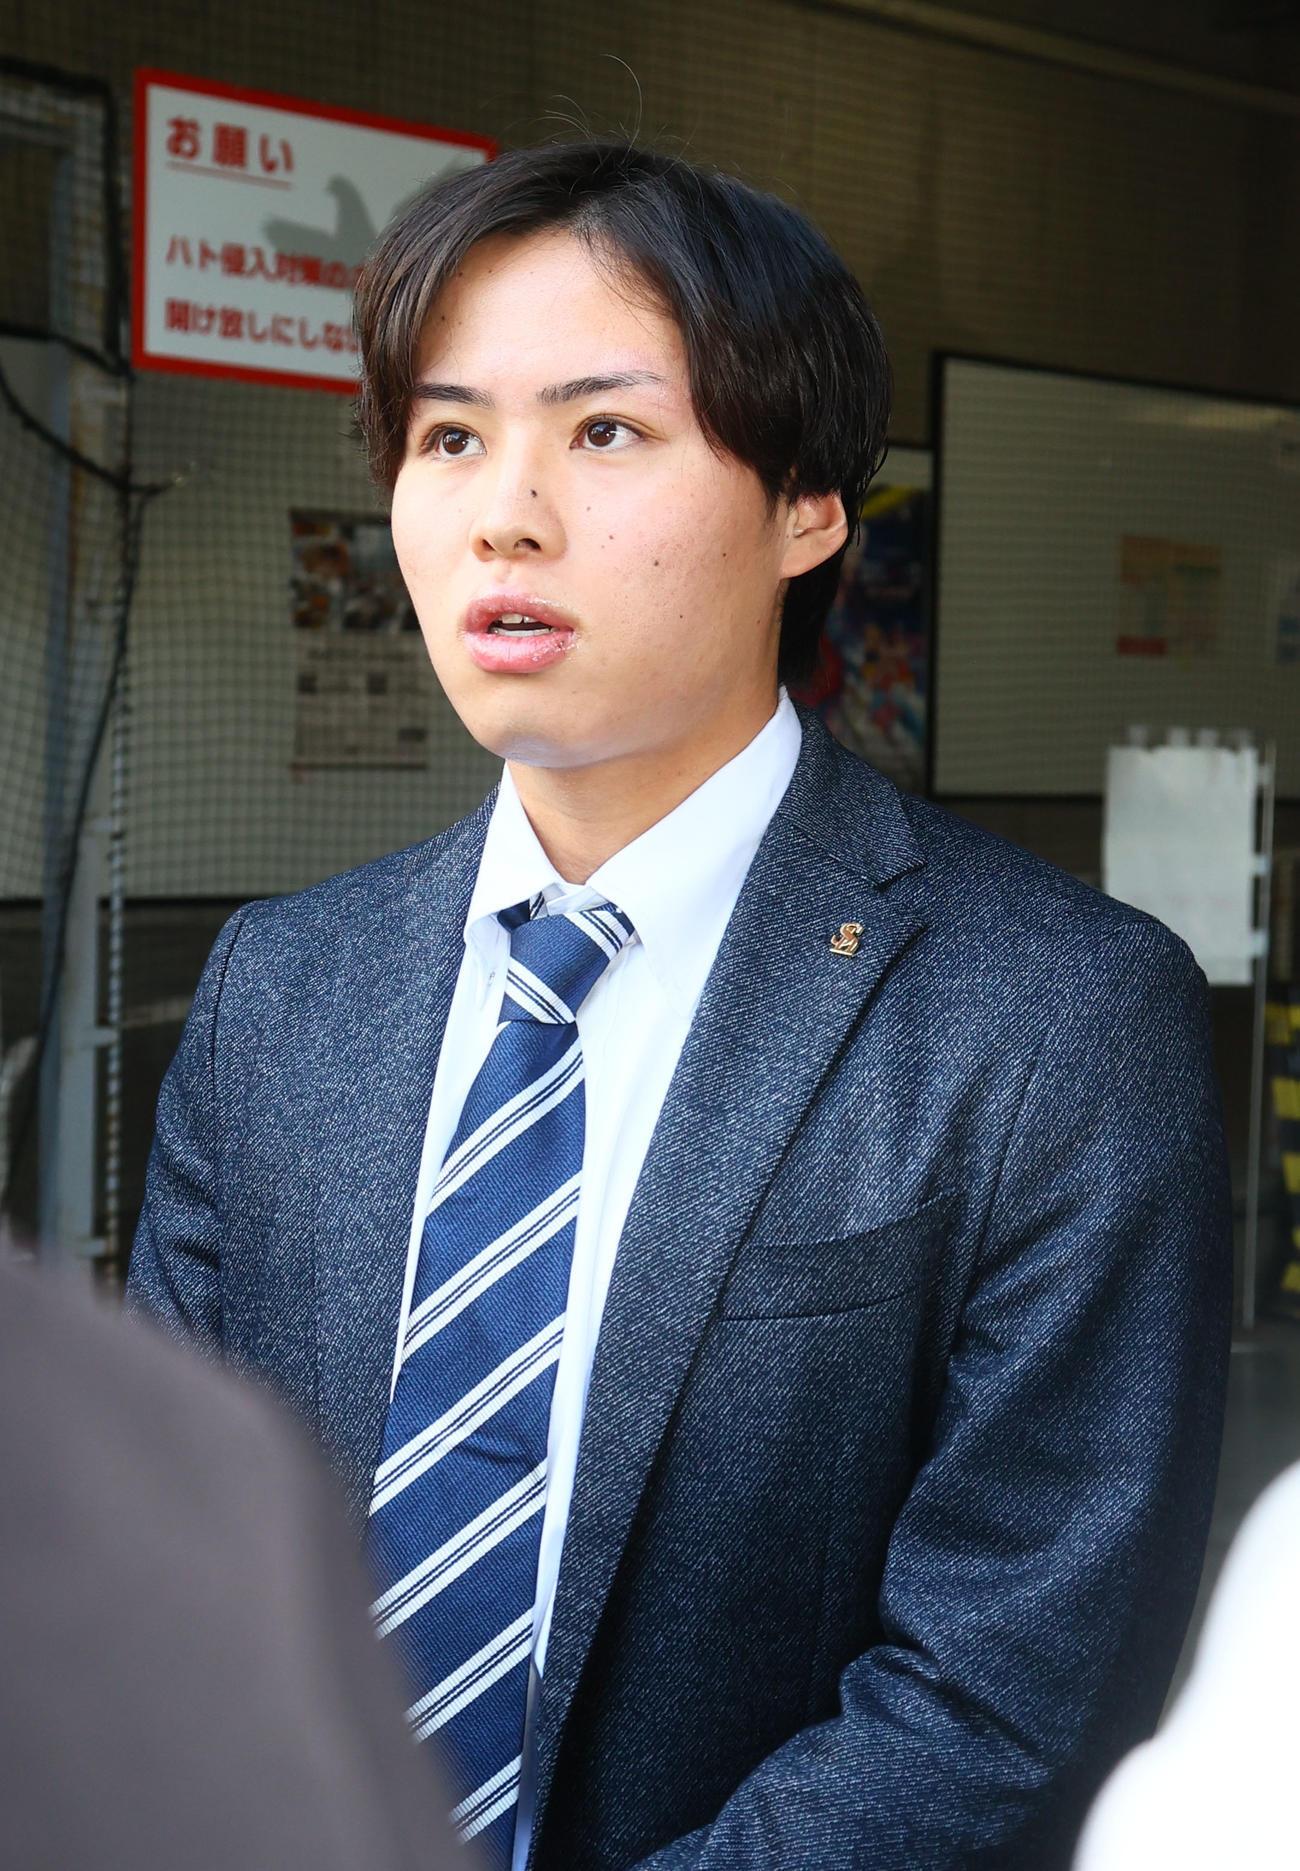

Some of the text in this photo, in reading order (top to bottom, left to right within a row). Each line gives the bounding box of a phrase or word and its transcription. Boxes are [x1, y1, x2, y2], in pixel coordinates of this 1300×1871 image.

[166, 116, 293, 173] お願い
[165, 236, 361, 290] ハト侵入対策の
